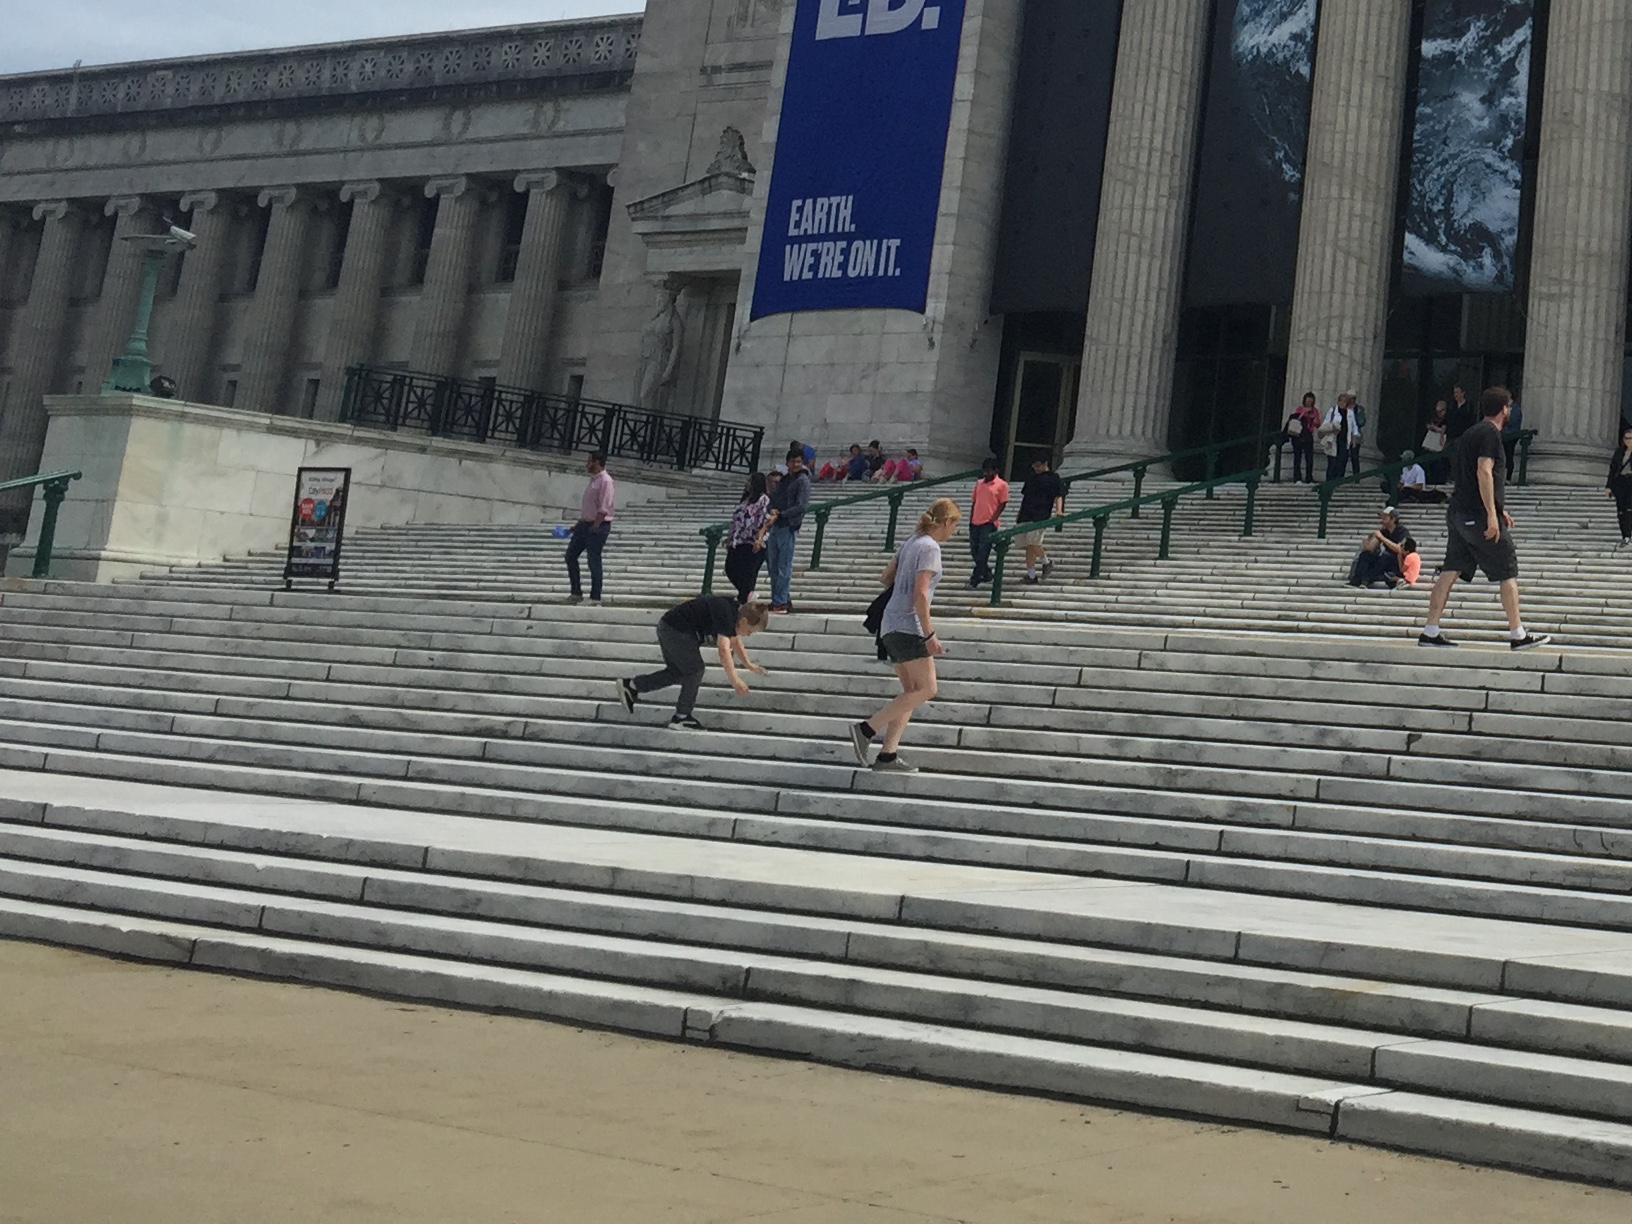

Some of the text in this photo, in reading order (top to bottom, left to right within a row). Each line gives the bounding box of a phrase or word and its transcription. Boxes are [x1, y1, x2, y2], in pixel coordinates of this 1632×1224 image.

[788, 194, 856, 237] EARTH.
[784, 238, 901, 282] WE'RE ON IT.
